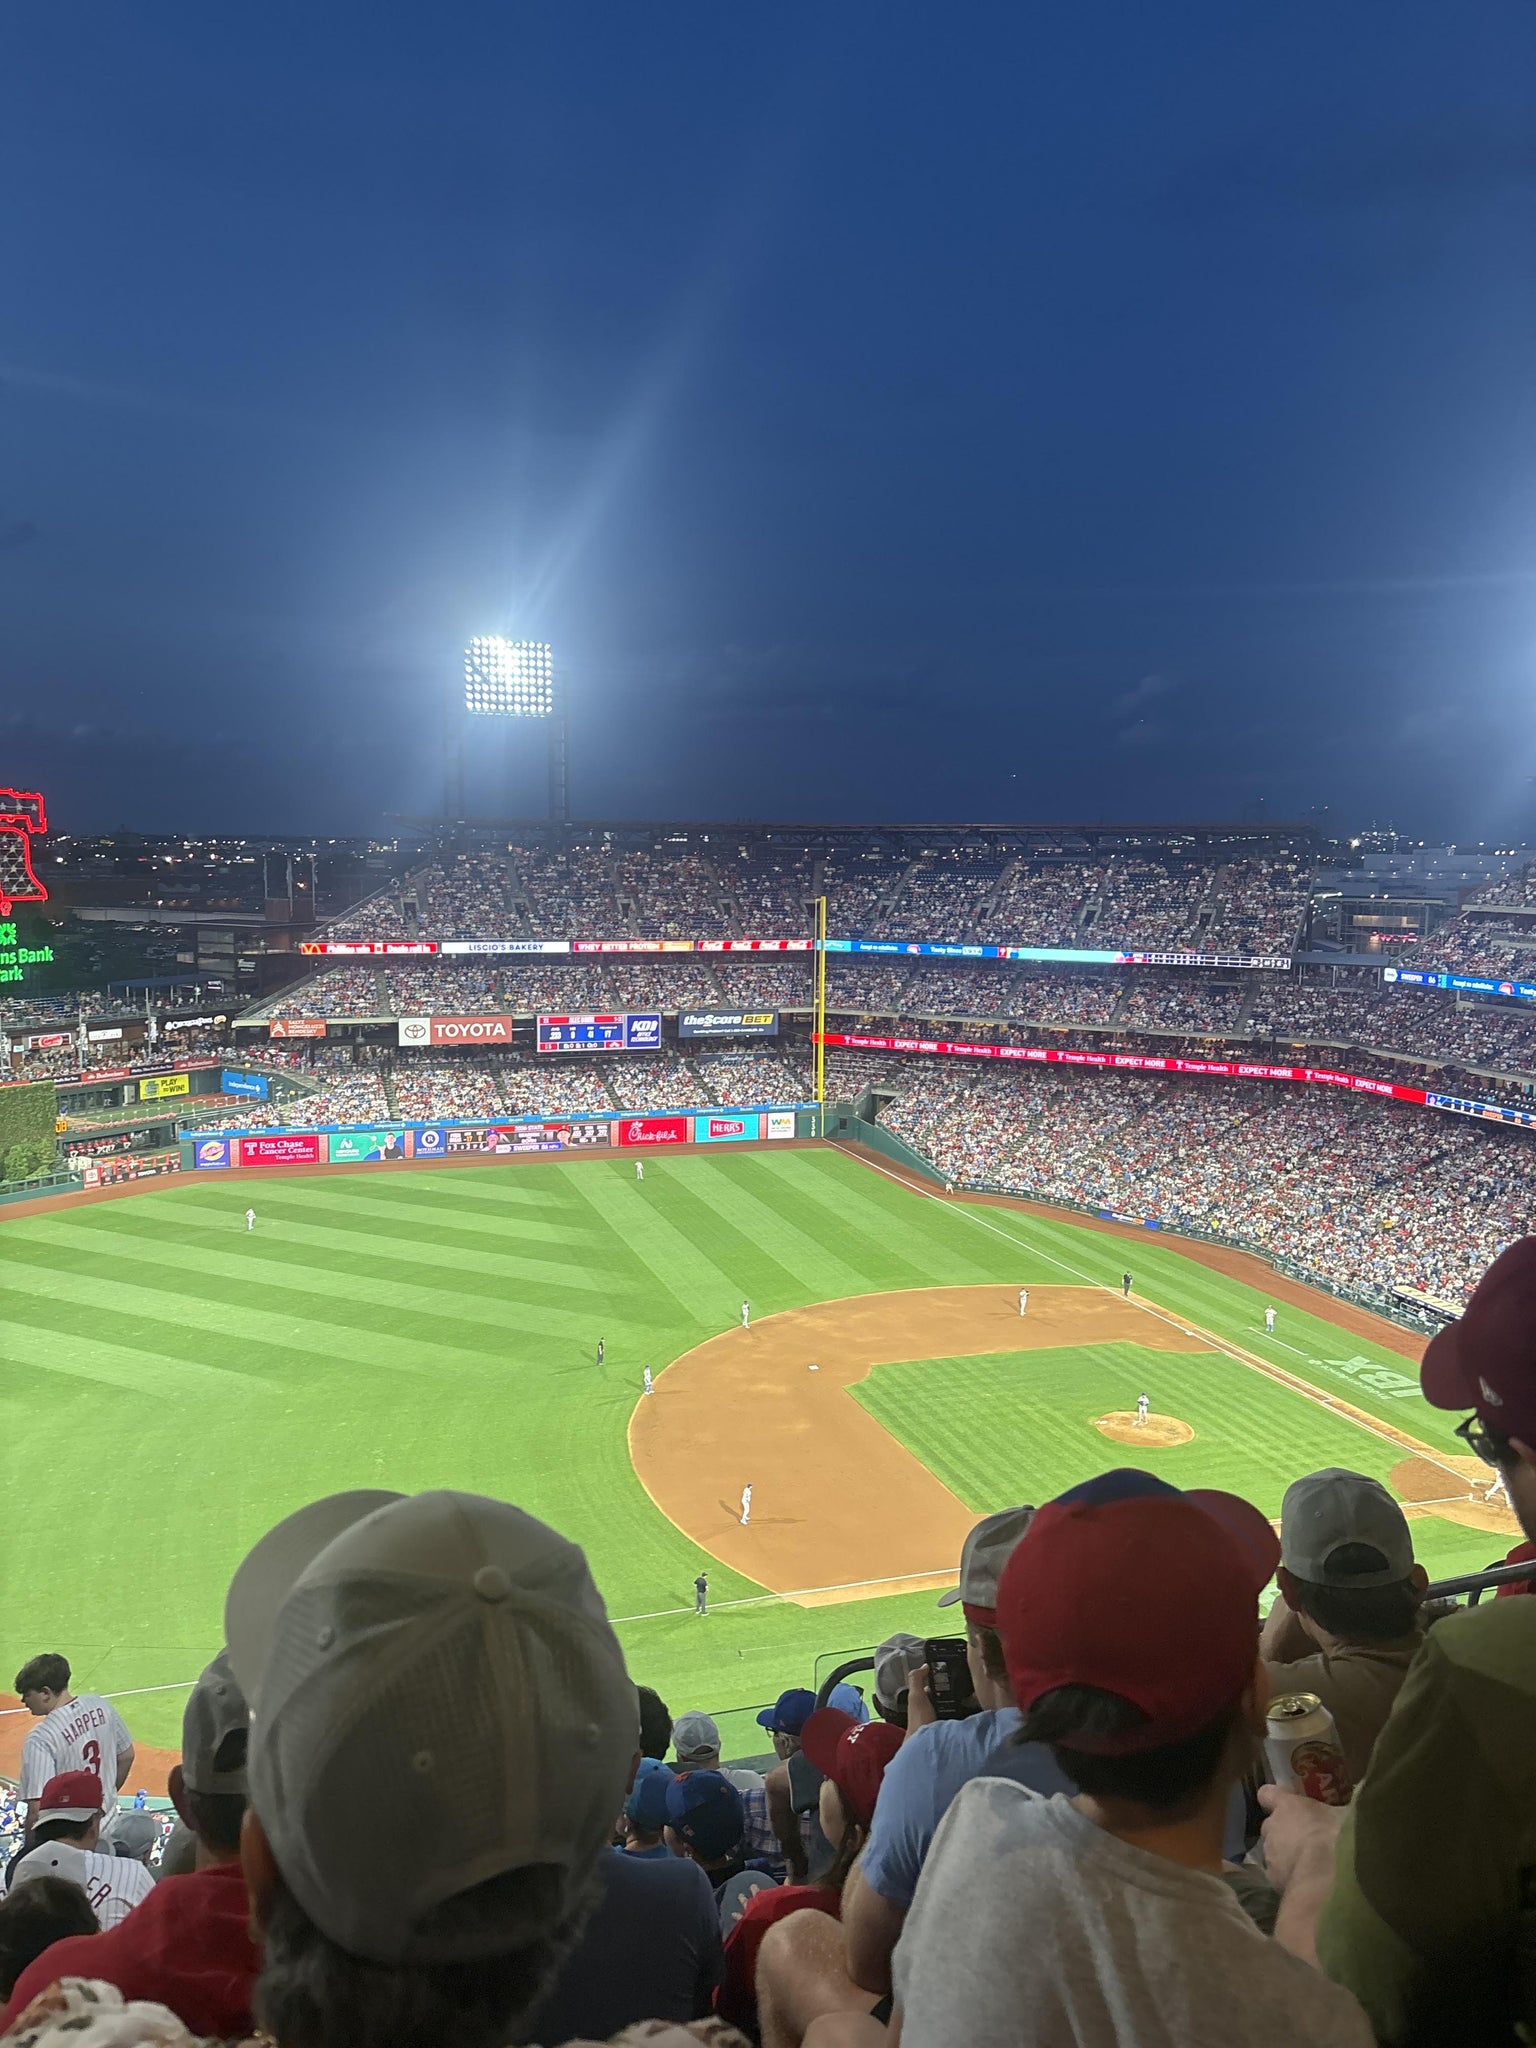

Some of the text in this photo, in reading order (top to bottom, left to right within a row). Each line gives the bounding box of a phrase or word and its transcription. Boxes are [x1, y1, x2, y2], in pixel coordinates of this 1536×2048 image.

[509, 943, 543, 951] BAKERY
[18, 946, 54, 964] Bank
[684, 1015, 771, 1026] theScore BET
[434, 1022, 506, 1038] TOYOTA
[851, 1038, 869, 1046] Temple
[894, 1041, 938, 1050] EXPECT MORE
[954, 1046, 973, 1054] Temple
[1000, 1049, 1047, 1059] EXPECT MORE
[1065, 1054, 1086, 1063] Temple
[1086, 1055, 1106, 1063] Health
[1115, 1057, 1165, 1067] EXPECT MORE
[187, 1060, 214, 1068] Budweiser
[1184, 1062, 1207, 1071] Temple
[1207, 1063, 1228, 1072] Health
[96, 1070, 125, 1079] Budweiser
[1238, 1066, 1293, 1077] EXPECT MORE
[1314, 1071, 1334, 1082] Temple
[1334, 1074, 1349, 1084] Health
[161, 1079, 177, 1087] PLAY
[1355, 1078, 1393, 1094] EXPECT MORE
[169, 1084, 185, 1093] WIN!
[771, 1118, 791, 1126] WM
[712, 1122, 741, 1133] HERR'S
[628, 1124, 678, 1142] Chick-fil-A
[260, 1141, 275, 1149] Fox
[61, 1707, 106, 1746] HARPER
[83, 1740, 101, 1777] 3
